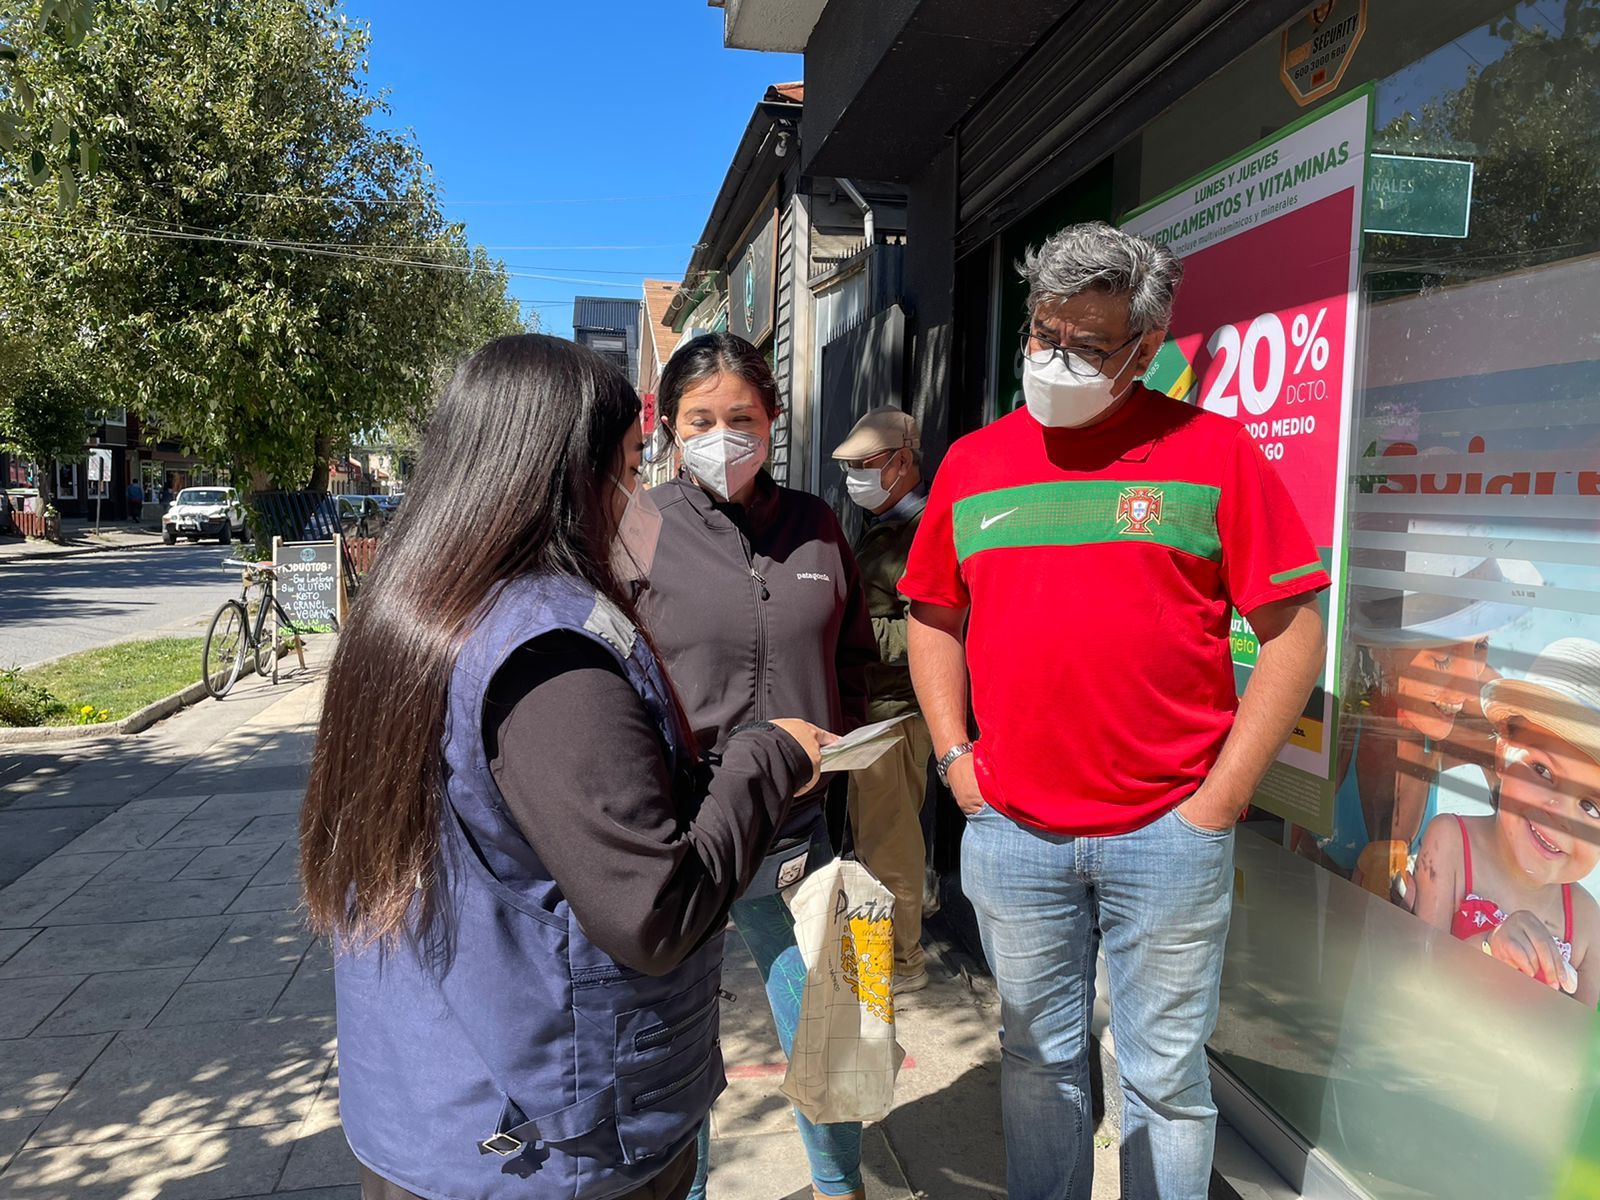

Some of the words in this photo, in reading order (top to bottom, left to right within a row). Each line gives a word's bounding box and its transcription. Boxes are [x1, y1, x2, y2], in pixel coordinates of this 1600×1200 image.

[1312, 13, 1359, 54] SECURITY
[1194, 175, 1226, 206] LUNES
[1227, 172, 1236, 187] Y
[1236, 149, 1280, 183] JUEVES
[1246, 186, 1257, 210] Y
[1258, 140, 1350, 199] VITAMINAS
[1260, 194, 1298, 219] minerales
[1271, 414, 1316, 438] MEDIO
[796, 571, 831, 582] patagonia
